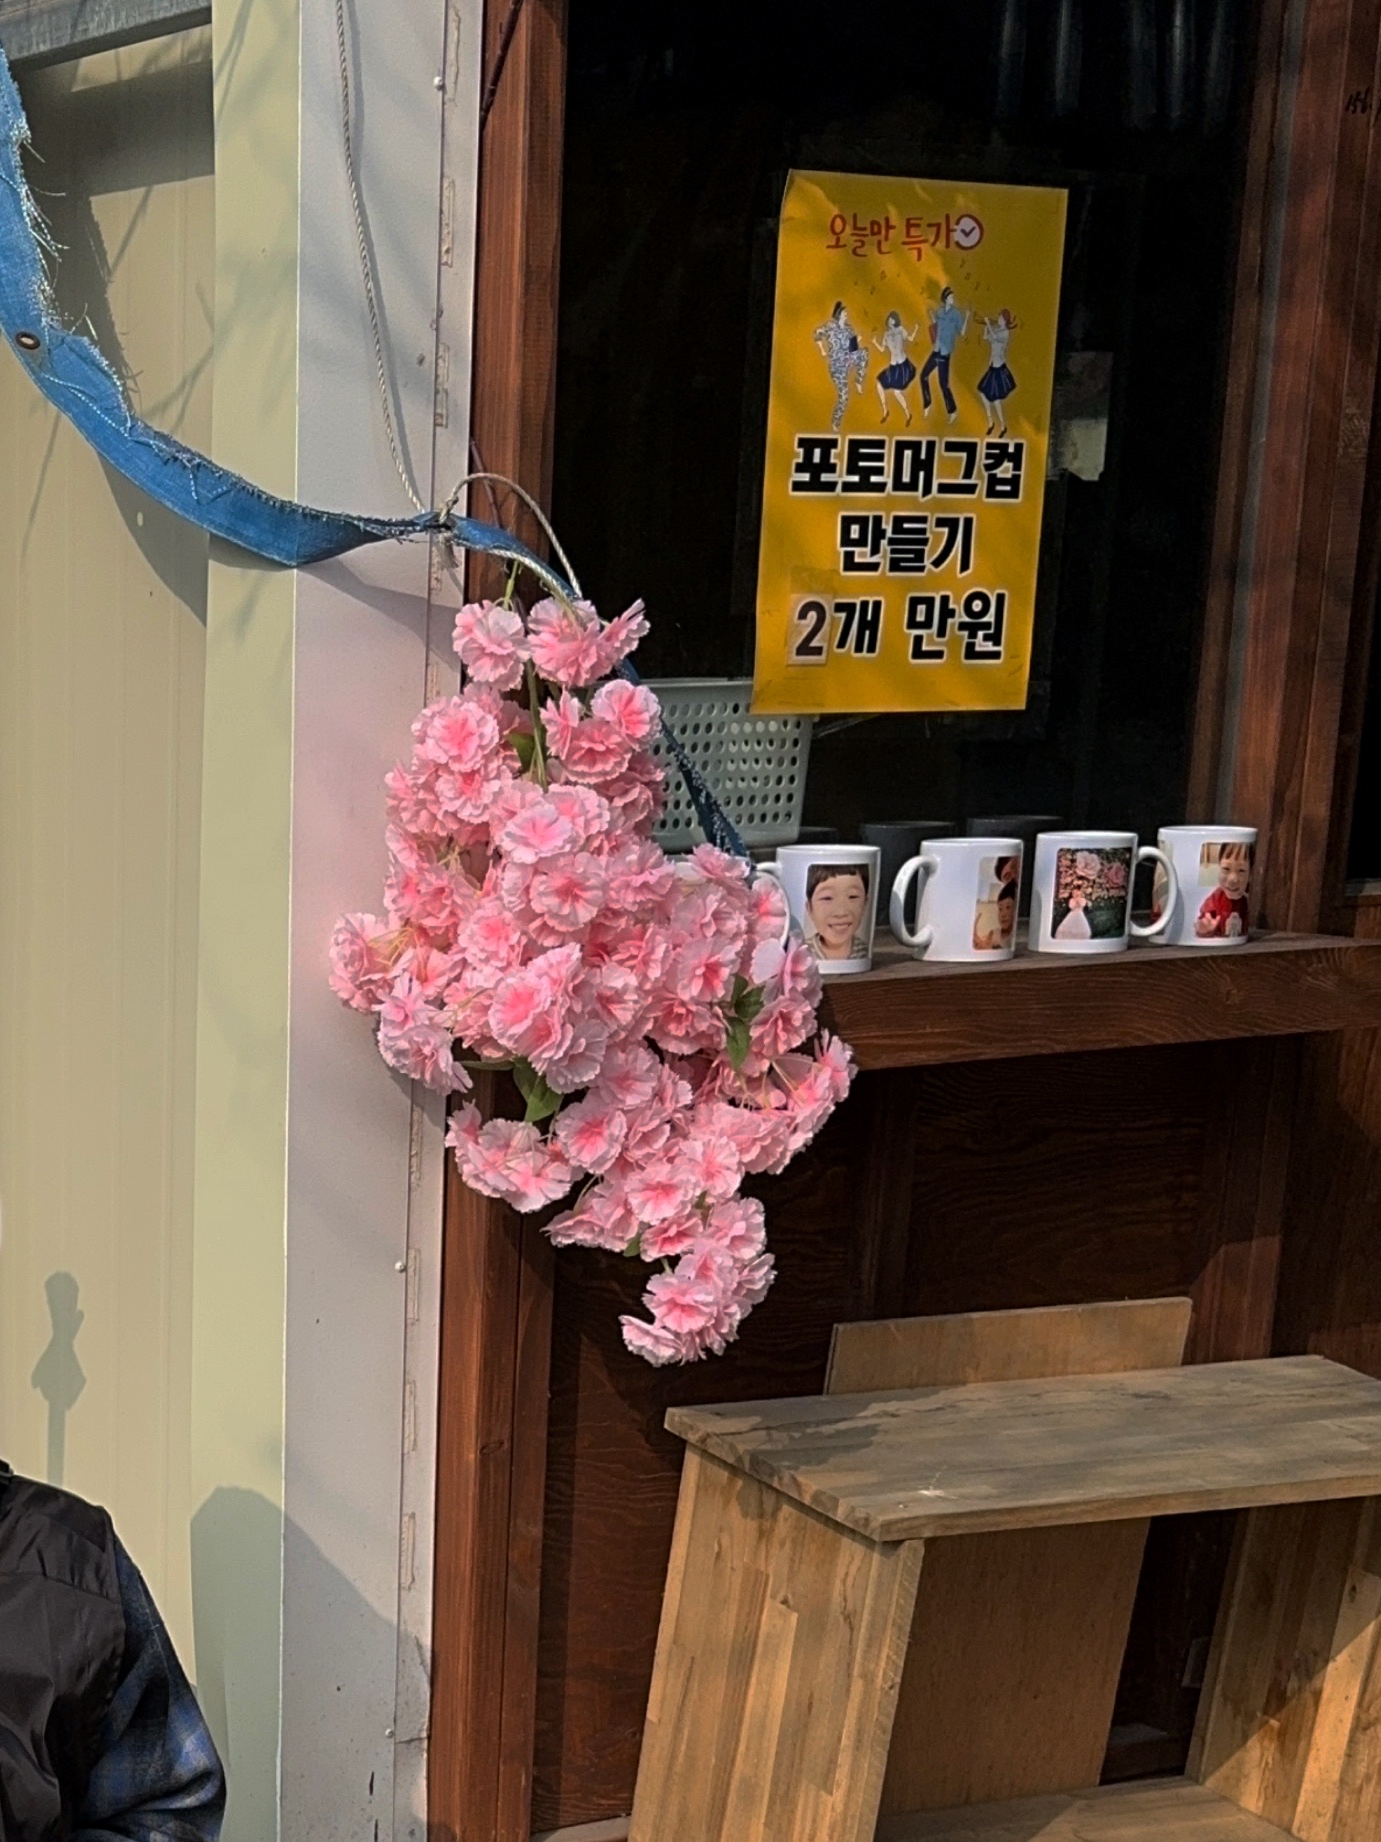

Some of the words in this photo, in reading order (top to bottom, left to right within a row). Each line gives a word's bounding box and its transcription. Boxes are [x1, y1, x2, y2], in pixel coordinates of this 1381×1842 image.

[826, 214, 897, 258] 오늘만
[902, 215, 956, 261] 특가
[790, 435, 1024, 502] 포토머그컵
[838, 511, 976, 576] 만들기
[793, 595, 883, 660] 2개
[905, 589, 1008, 663] 만원
